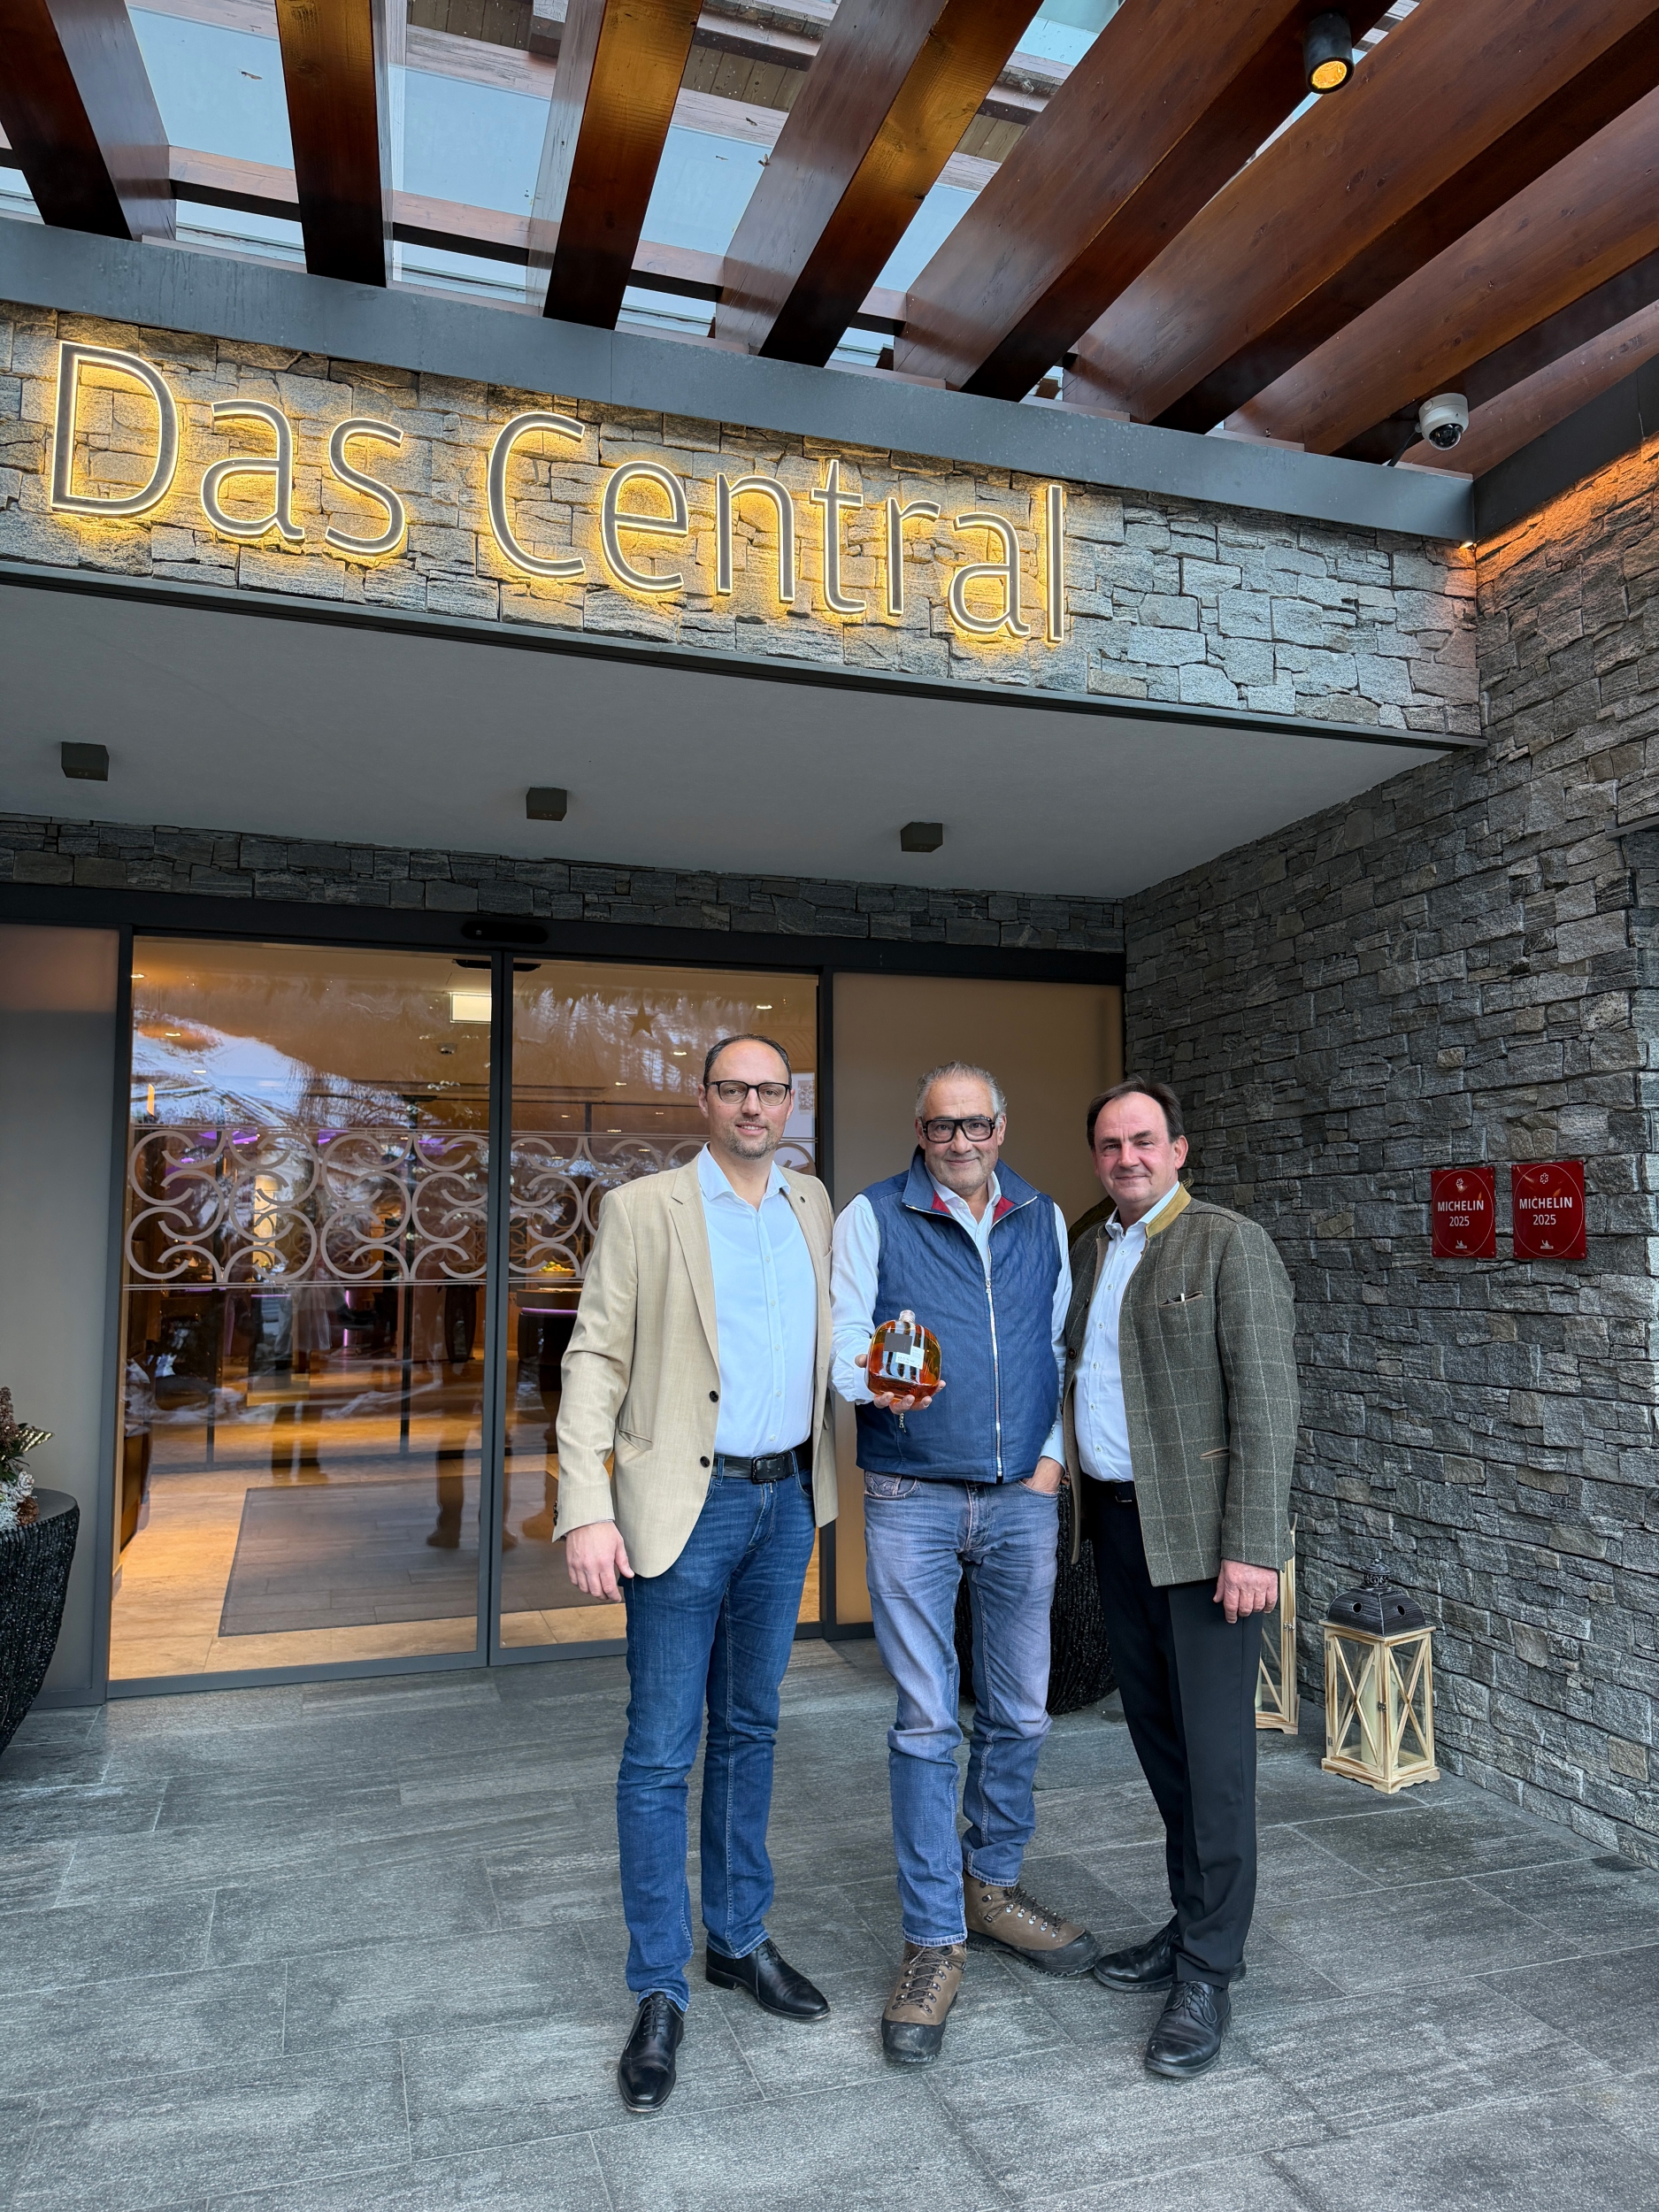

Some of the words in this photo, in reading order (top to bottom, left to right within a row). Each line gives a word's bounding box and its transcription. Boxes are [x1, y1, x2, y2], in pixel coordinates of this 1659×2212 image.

[50, 340, 406, 556] Das
[488, 411, 1064, 643] Central
[1437, 1200, 1485, 1212] MICHELIN
[1518, 1196, 1573, 1210] MICHELIN
[1448, 1216, 1470, 1227] 2025
[1532, 1214, 1556, 1225] 2025
